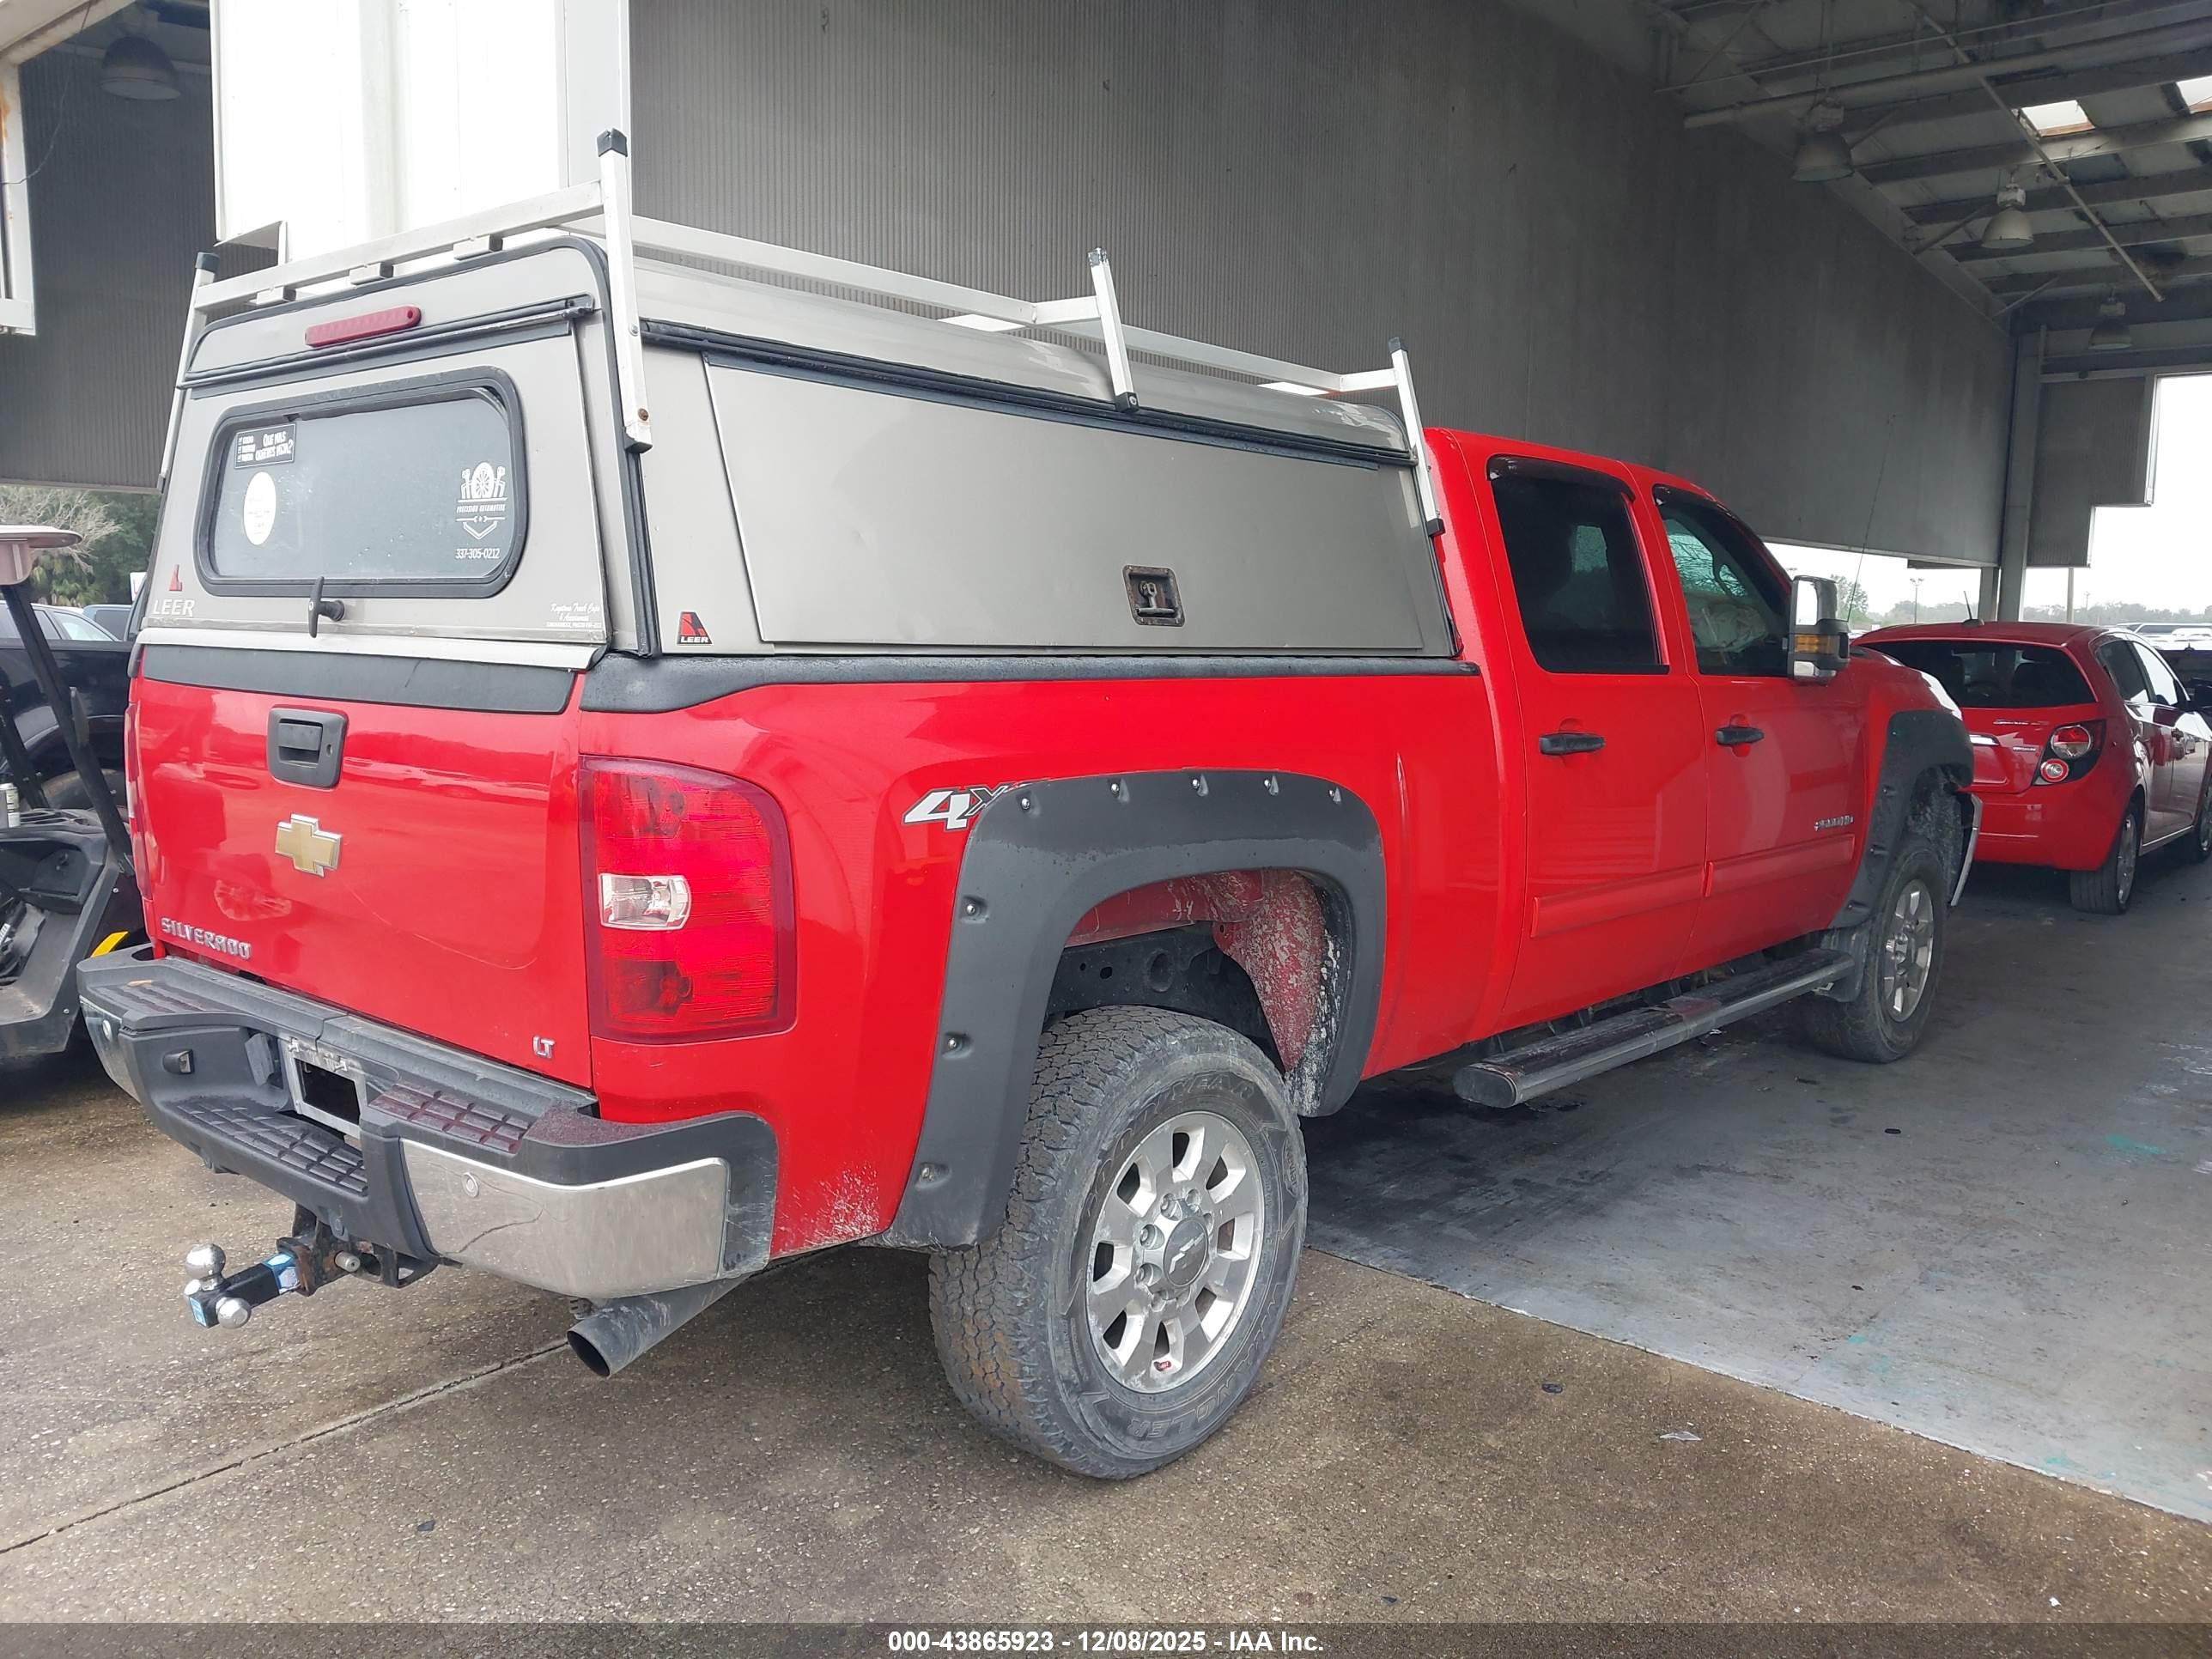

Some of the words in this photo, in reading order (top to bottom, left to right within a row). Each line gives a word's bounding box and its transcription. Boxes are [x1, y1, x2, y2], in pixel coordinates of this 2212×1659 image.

[151, 599, 196, 617] LEER
[680, 635, 709, 644] LEER
[160, 917, 252, 960] SILVERADO
[532, 1036, 556, 1059] LT
